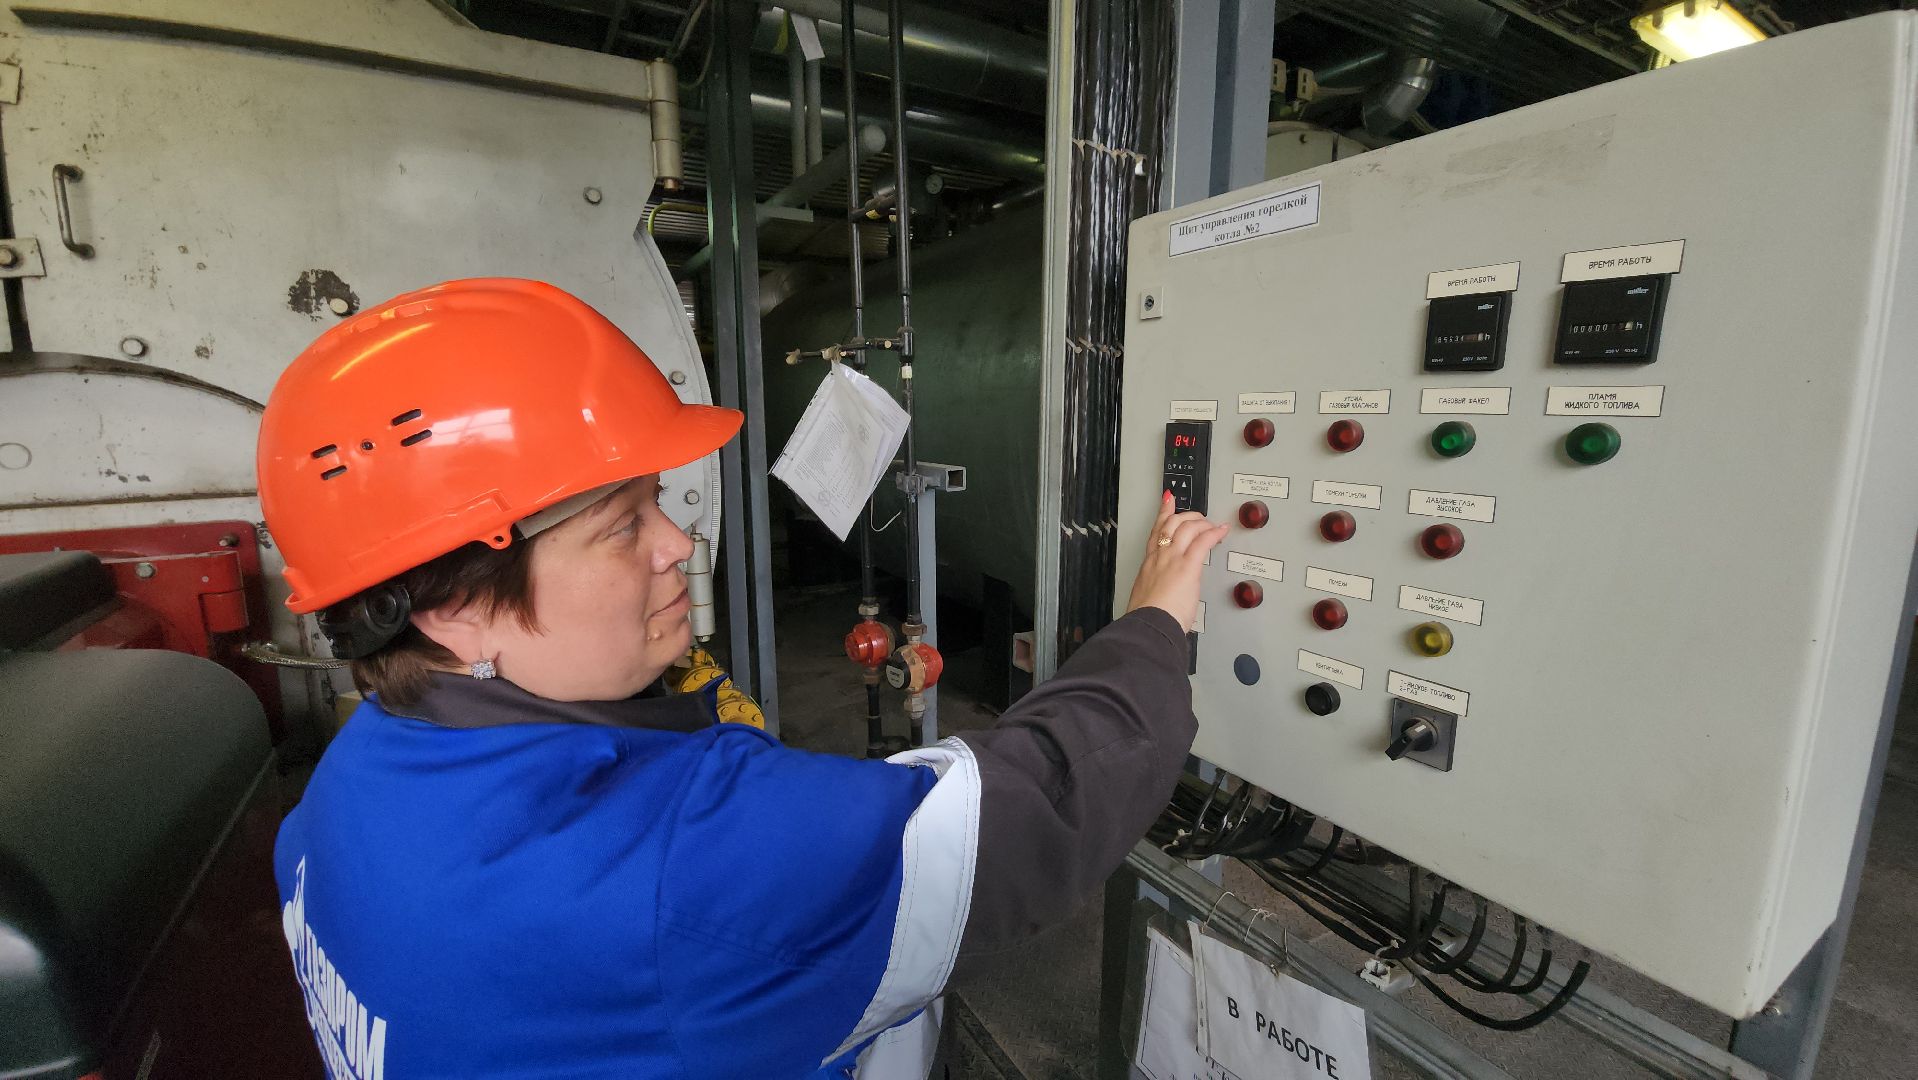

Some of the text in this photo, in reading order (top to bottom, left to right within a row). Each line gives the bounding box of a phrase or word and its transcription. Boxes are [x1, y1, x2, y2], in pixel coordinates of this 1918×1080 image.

[1178, 194, 1308, 237] Щит управления горелкой
[1214, 222, 1261, 243] котла №2
[1588, 256, 1652, 270] ВРЕМЯ РАБОТЫ
[1564, 401, 1640, 410] ЖИДКОГО ТОПЛИВА
[1588, 393, 1617, 401] ПЛАМЯ
[1226, 996, 1241, 1020] В
[1255, 1011, 1340, 1080] РАБОТЕ
